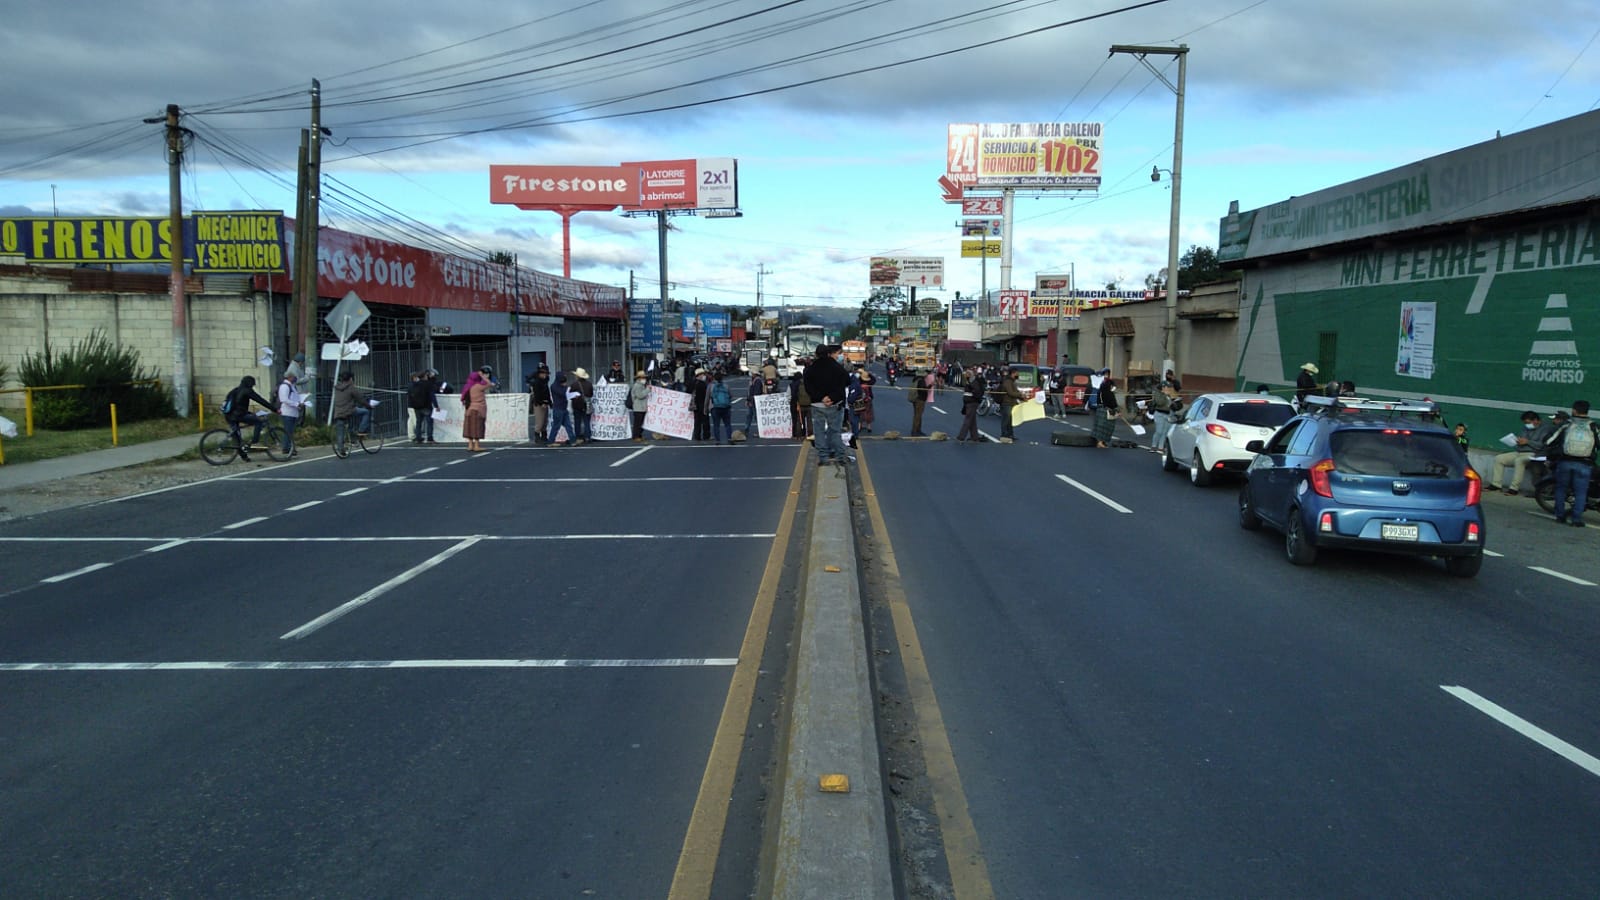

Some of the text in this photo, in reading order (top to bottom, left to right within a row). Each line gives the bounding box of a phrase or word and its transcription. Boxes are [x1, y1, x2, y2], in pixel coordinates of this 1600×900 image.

[1064, 122, 1101, 137] GALENO
[950, 136, 975, 173] 24
[984, 141, 1037, 154] SERVICIO A
[983, 157, 1036, 173] DOMICILIO
[1042, 140, 1099, 174] 1702
[646, 168, 686, 179] LATORRE
[703, 169, 729, 185] 2x1
[502, 175, 628, 195] Firestone
[966, 201, 999, 212] 24
[197, 216, 279, 242] MECANICA
[32, 220, 173, 259] FRENOS
[196, 243, 281, 269] Y SERVICIO
[1340, 252, 1383, 286] MINI
[1110, 290, 1145, 299] GALENO
[1002, 297, 1026, 315] 24
[1526, 359, 1581, 369] cementos
[1522, 368, 1584, 384] PROGRESO
